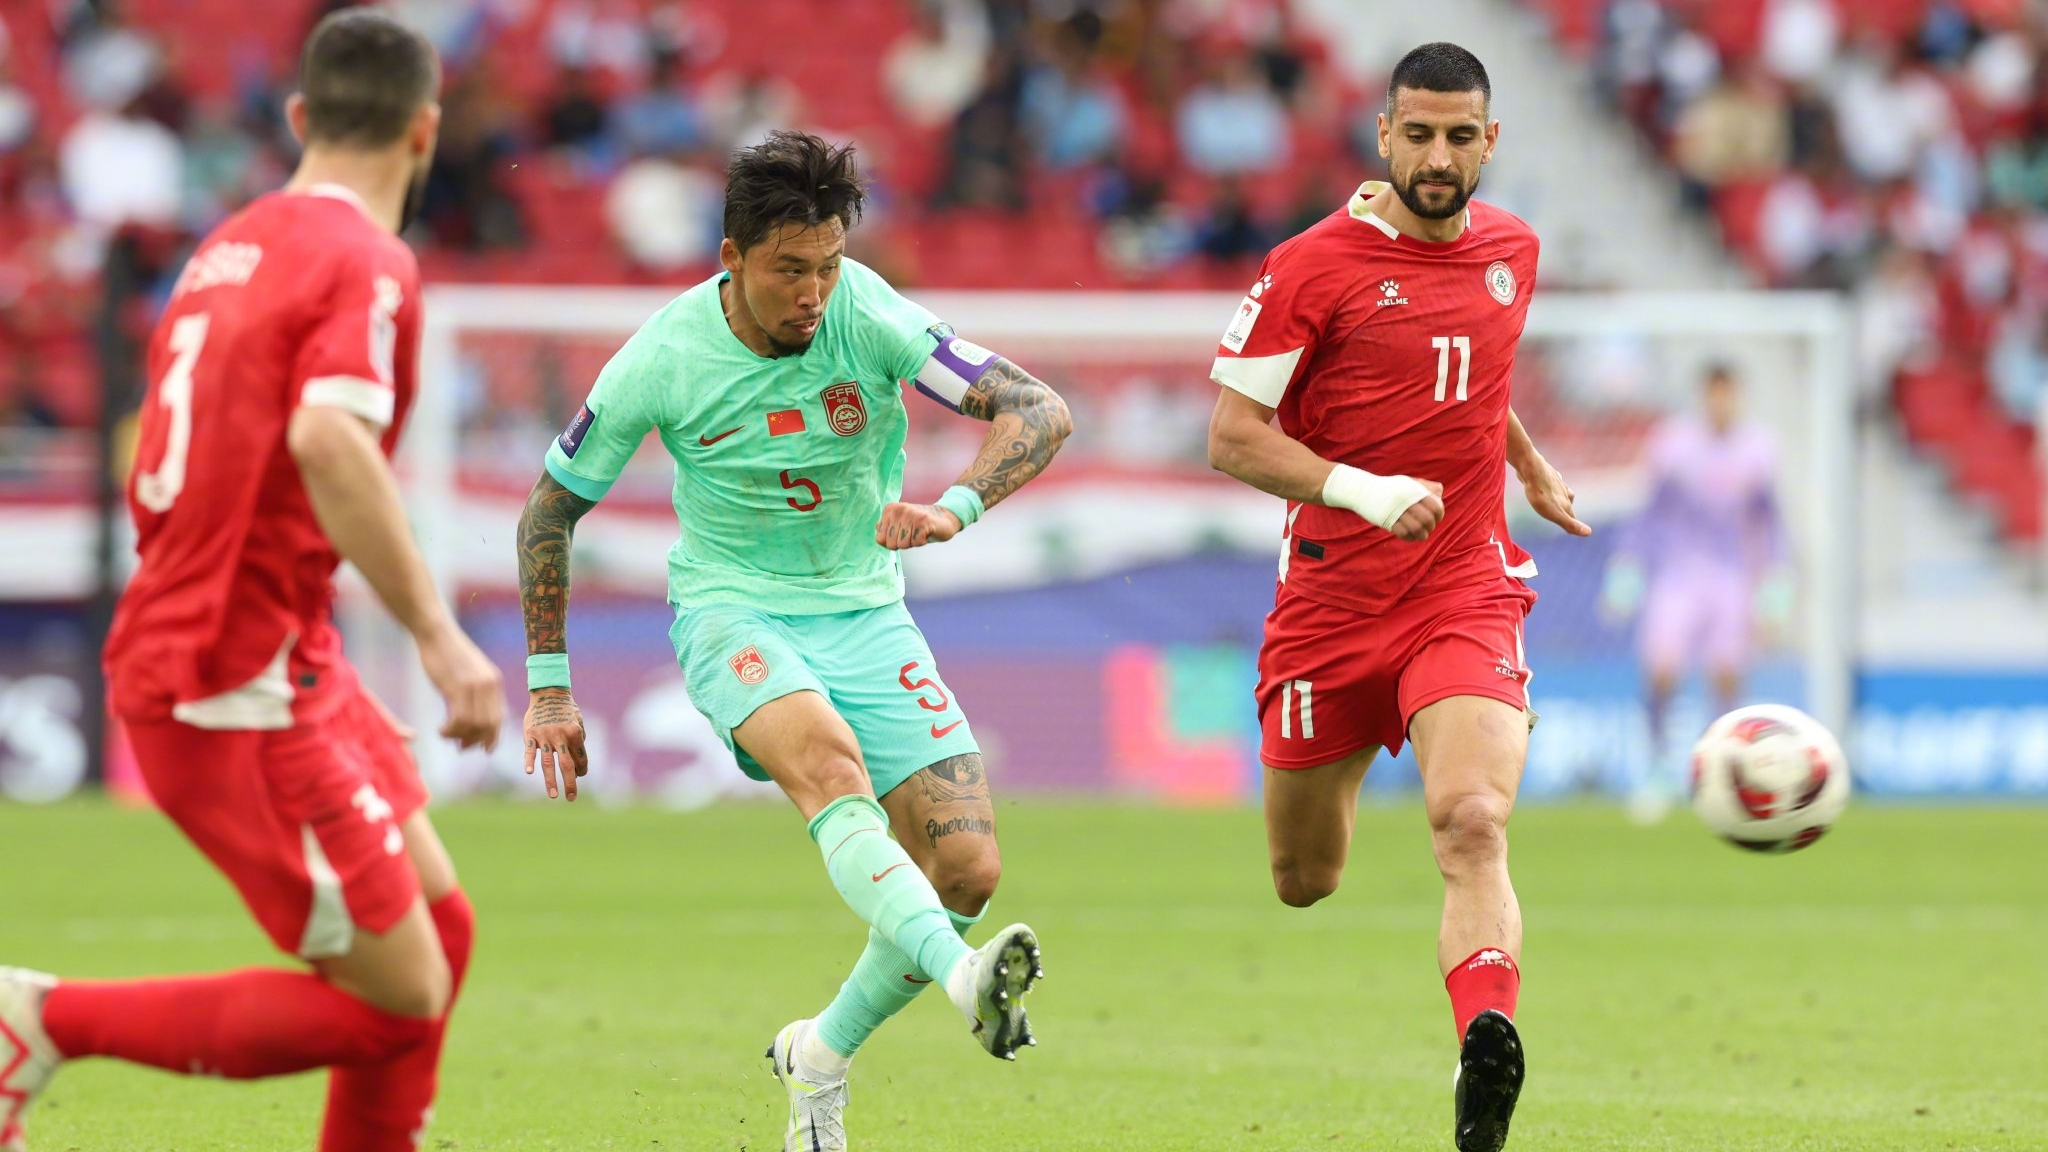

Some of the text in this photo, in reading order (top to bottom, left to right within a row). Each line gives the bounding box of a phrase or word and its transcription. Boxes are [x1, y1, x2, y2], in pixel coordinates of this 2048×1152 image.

[1376, 297, 1409, 307] KELME
[825, 386, 856, 400] CFA
[1431, 336, 1471, 402] 11
[135, 312, 211, 513] 3
[779, 469, 822, 512] 5
[899, 661, 948, 712] 5
[1280, 679, 1315, 739] 11
